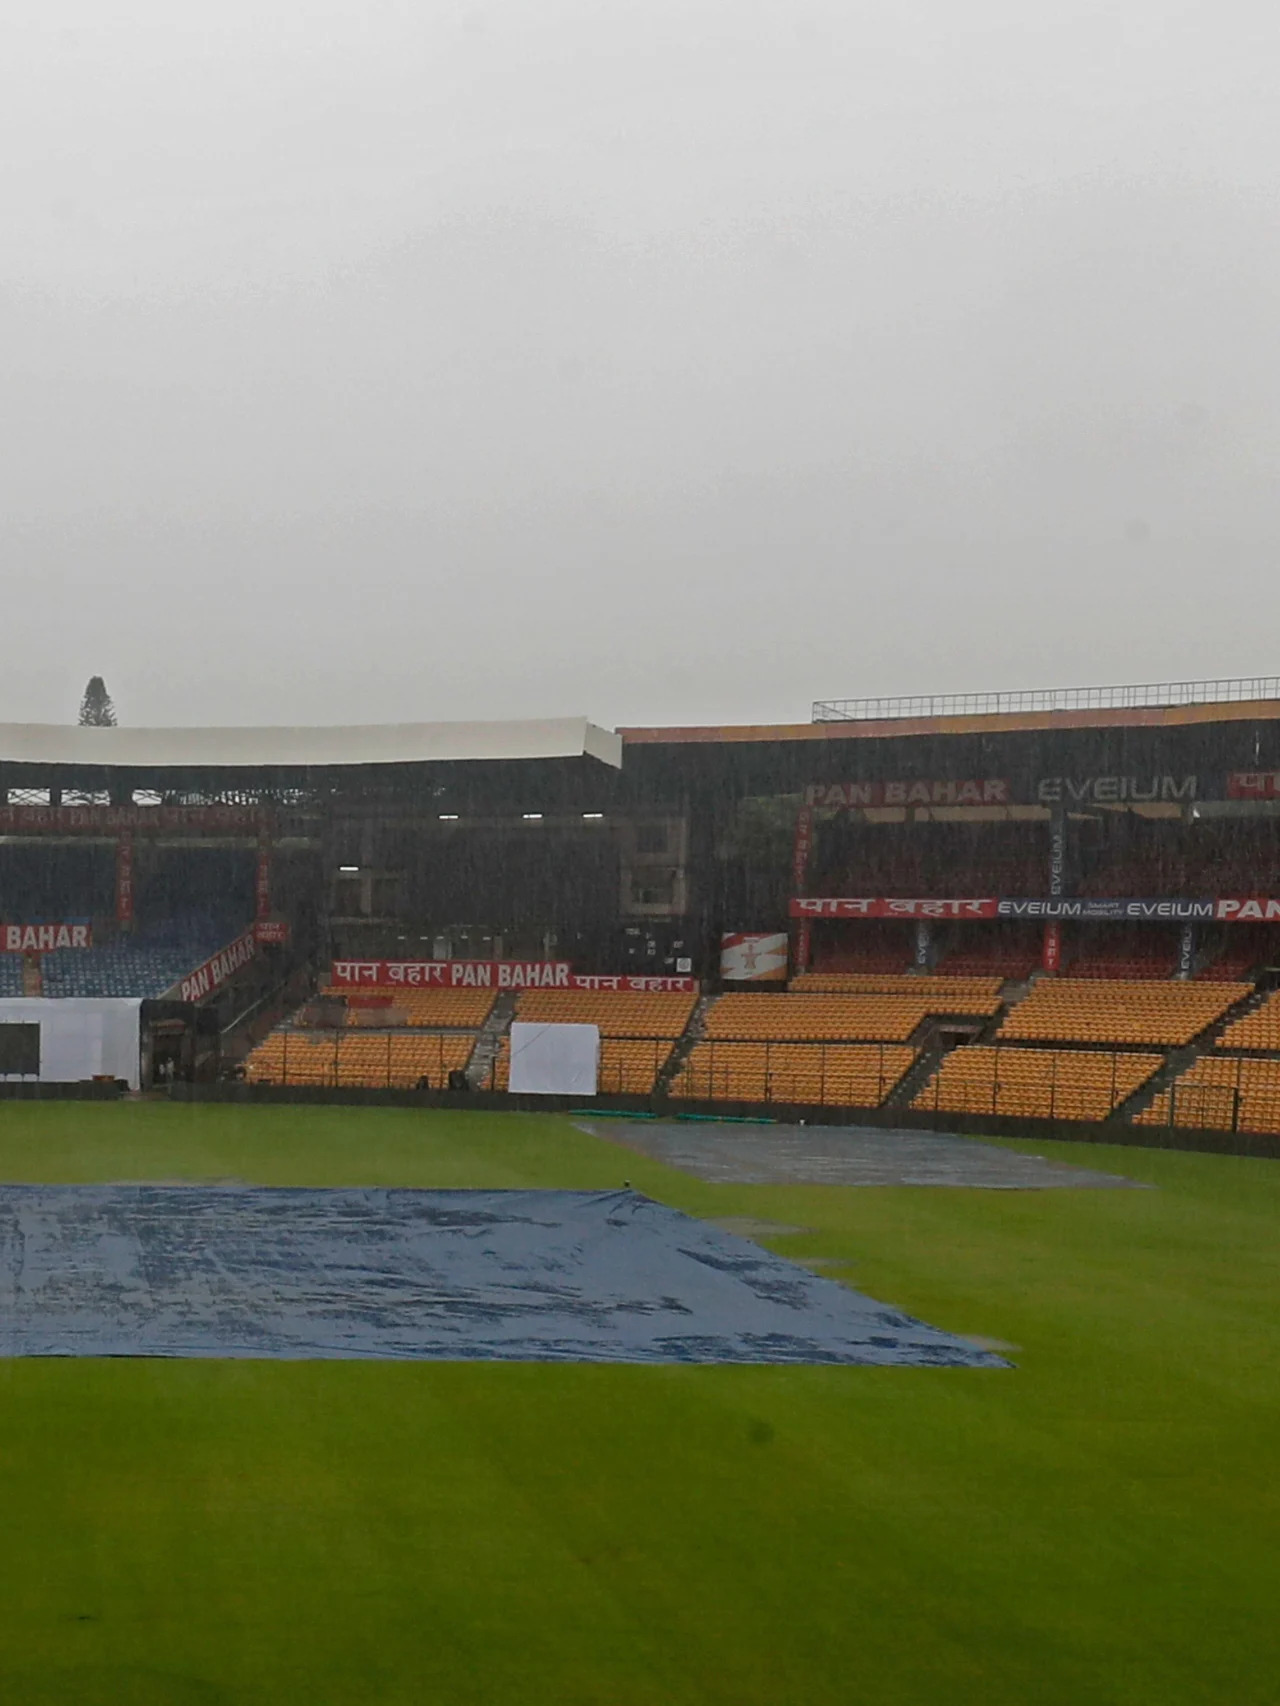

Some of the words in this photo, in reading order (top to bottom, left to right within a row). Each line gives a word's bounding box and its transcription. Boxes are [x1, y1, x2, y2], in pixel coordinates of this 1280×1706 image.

[805, 784, 872, 806] PAN
[884, 779, 1009, 804] BAHAR
[1037, 774, 1199, 801] EVEIUM
[794, 898, 876, 914] पान
[997, 901, 1081, 915] EVEIUM
[1127, 901, 1214, 916] EVEIUM
[6, 924, 90, 950] BAHAR
[180, 969, 210, 1002] PAN
[211, 933, 256, 984] BAHAR
[333, 962, 381, 982] पान
[451, 963, 491, 987] PAN
[498, 963, 569, 987] BAHAR
[573, 975, 622, 990] पान
